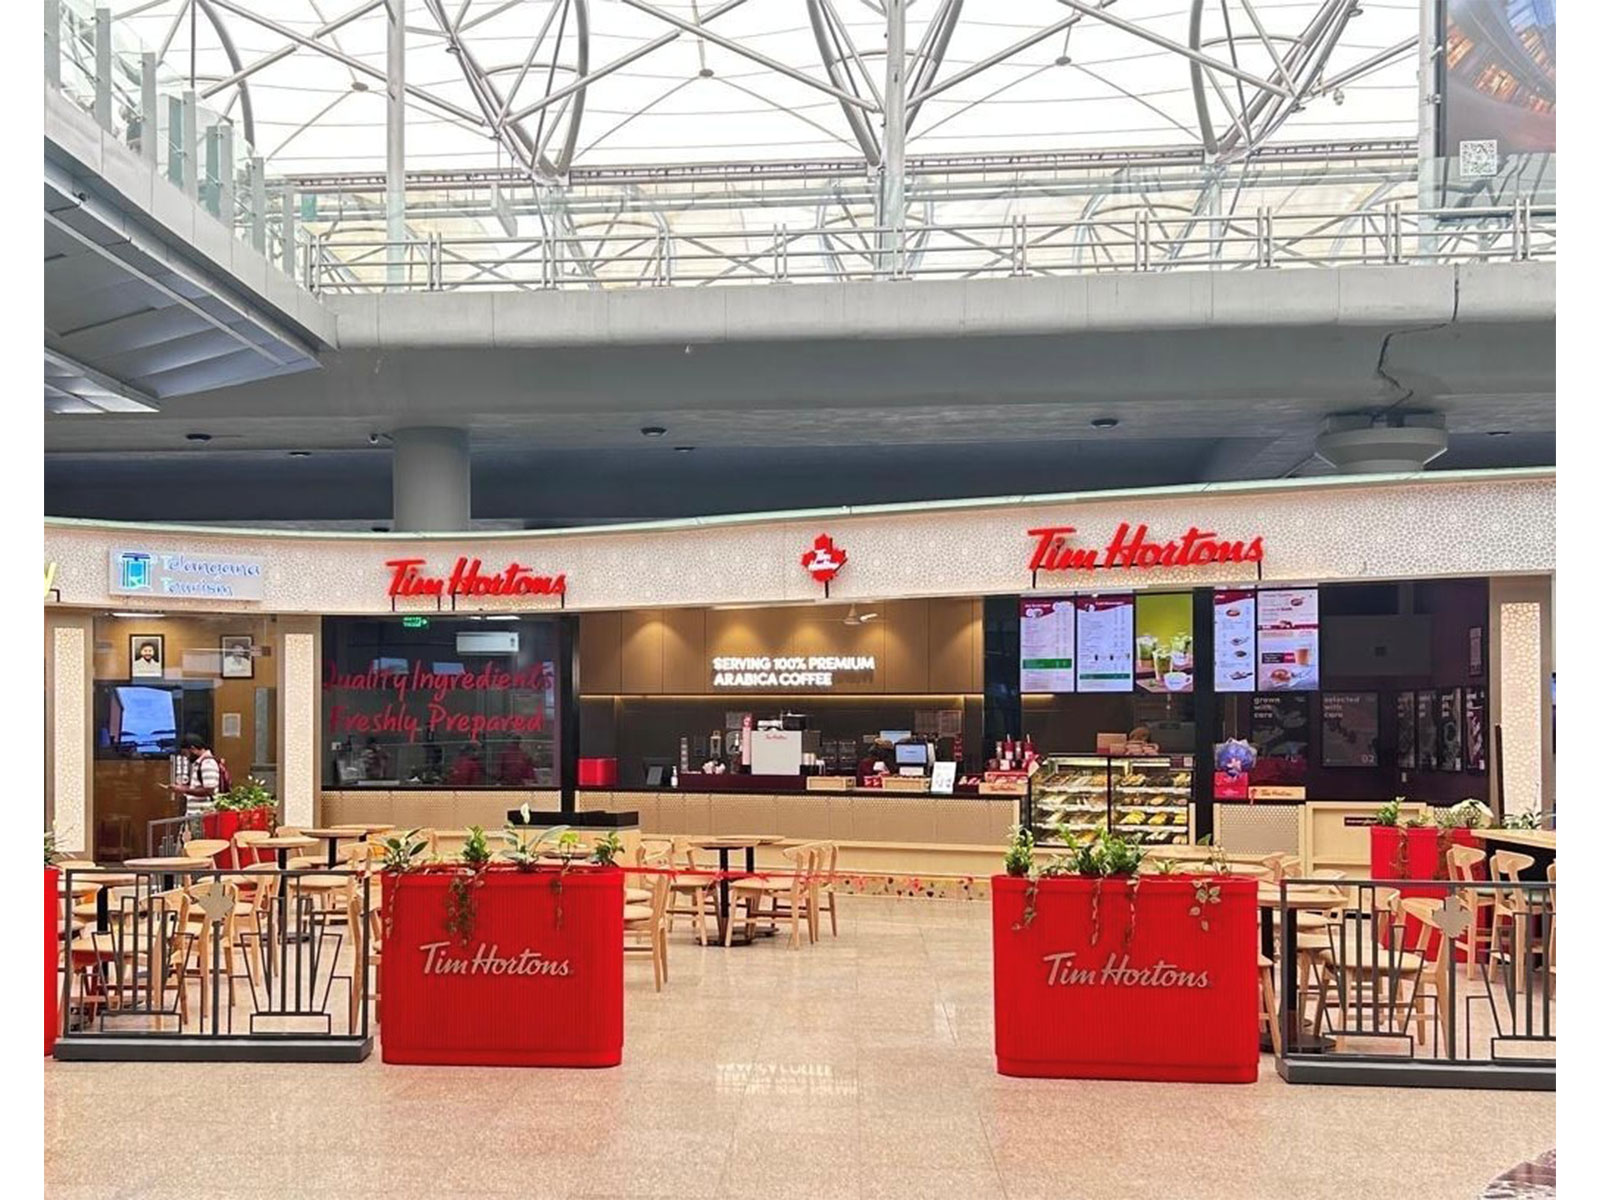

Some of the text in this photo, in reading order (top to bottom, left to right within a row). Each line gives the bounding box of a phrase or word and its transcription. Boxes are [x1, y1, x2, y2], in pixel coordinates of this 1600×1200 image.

[1027, 522, 1263, 571] Tim Hortons
[385, 557, 566, 596] Tim Hortons
[412, 659, 554, 701] Ingredients
[713, 656, 875, 670] SERVING 100% PREMIUM
[714, 672, 833, 686] ARABICA COFFEE
[329, 703, 544, 744] Freshly Prepared
[419, 941, 570, 976] Tim Hortons
[1043, 952, 1209, 988] Tim Hortons
